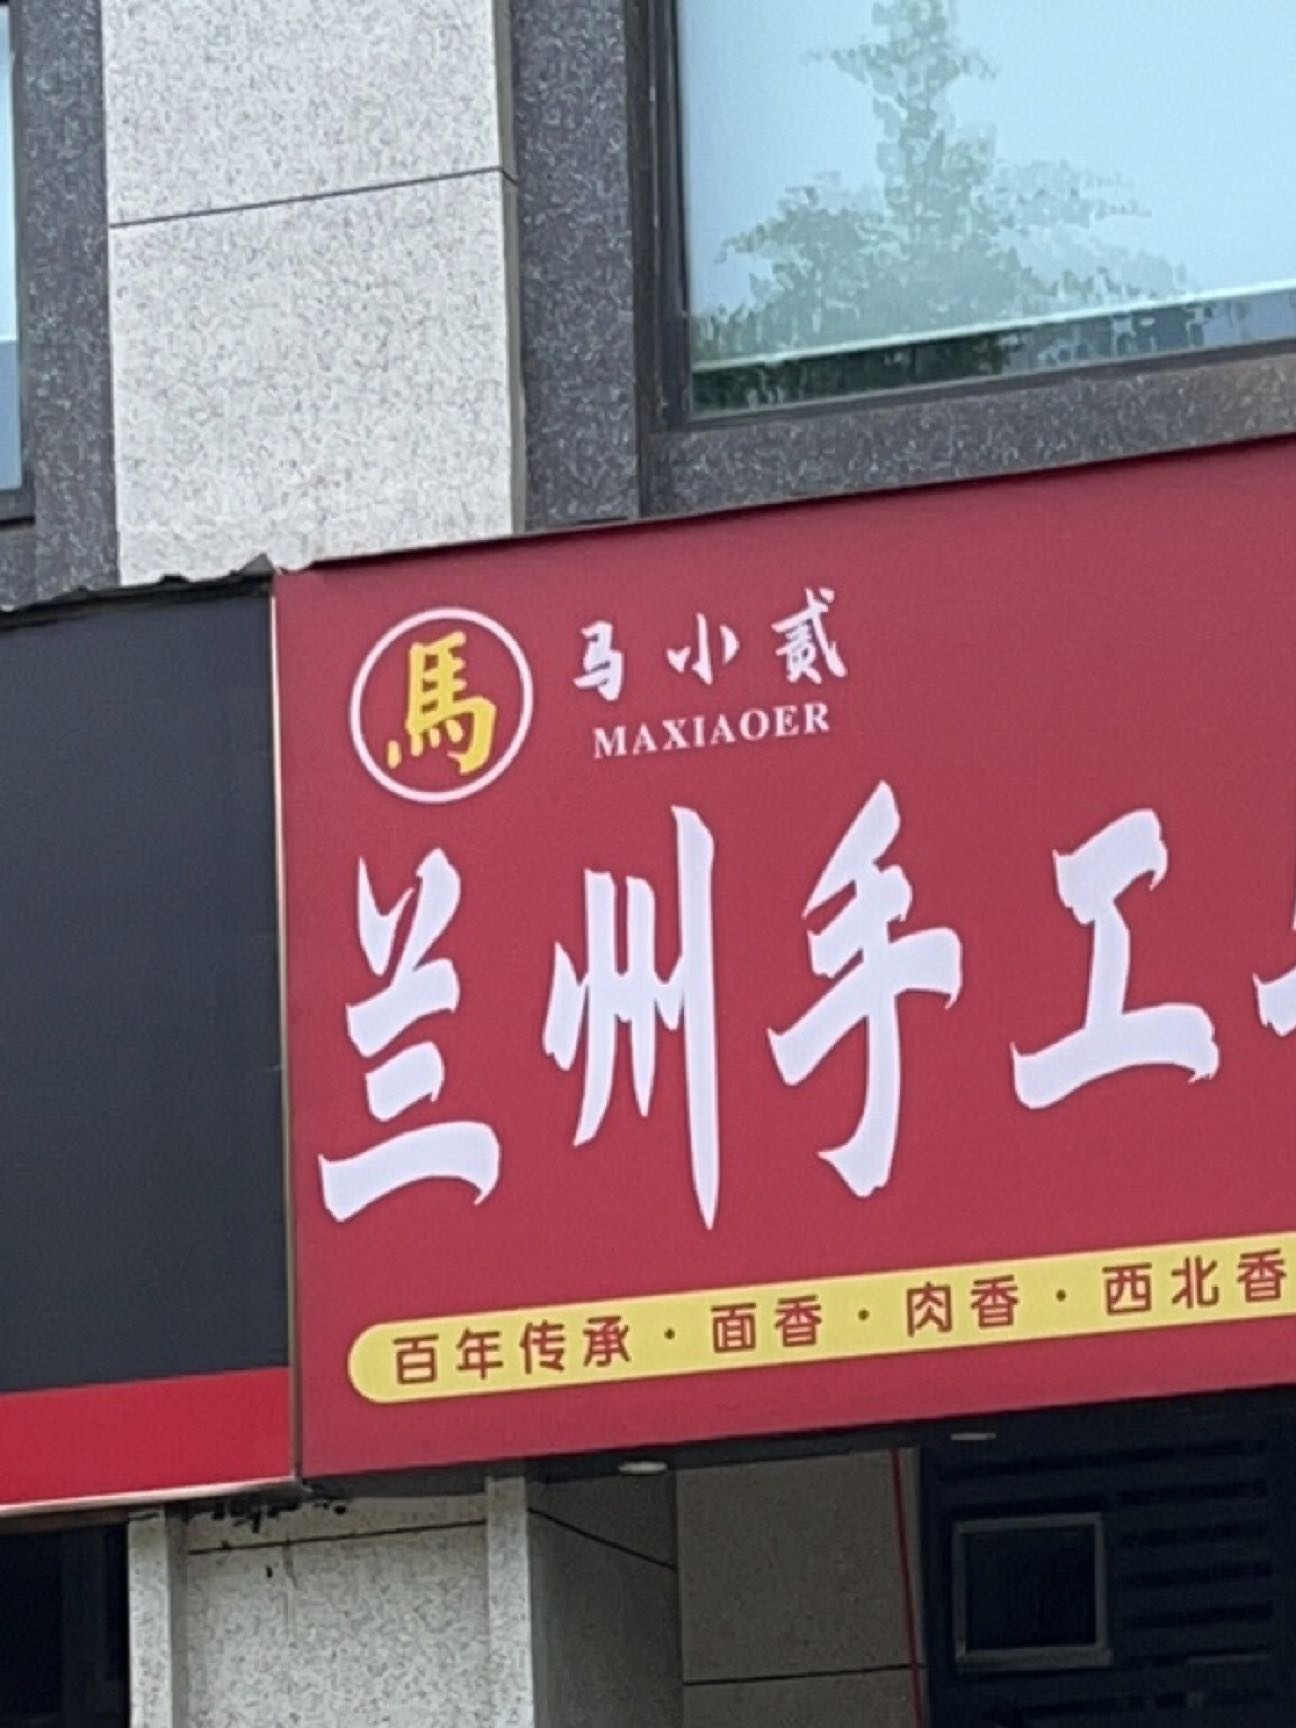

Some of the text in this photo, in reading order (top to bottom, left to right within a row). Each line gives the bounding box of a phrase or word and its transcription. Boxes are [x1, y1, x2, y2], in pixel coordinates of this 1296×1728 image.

[573, 587, 847, 702] 马小贰
[386, 631, 497, 775] 馬
[592, 702, 832, 760] MAXIAOER
